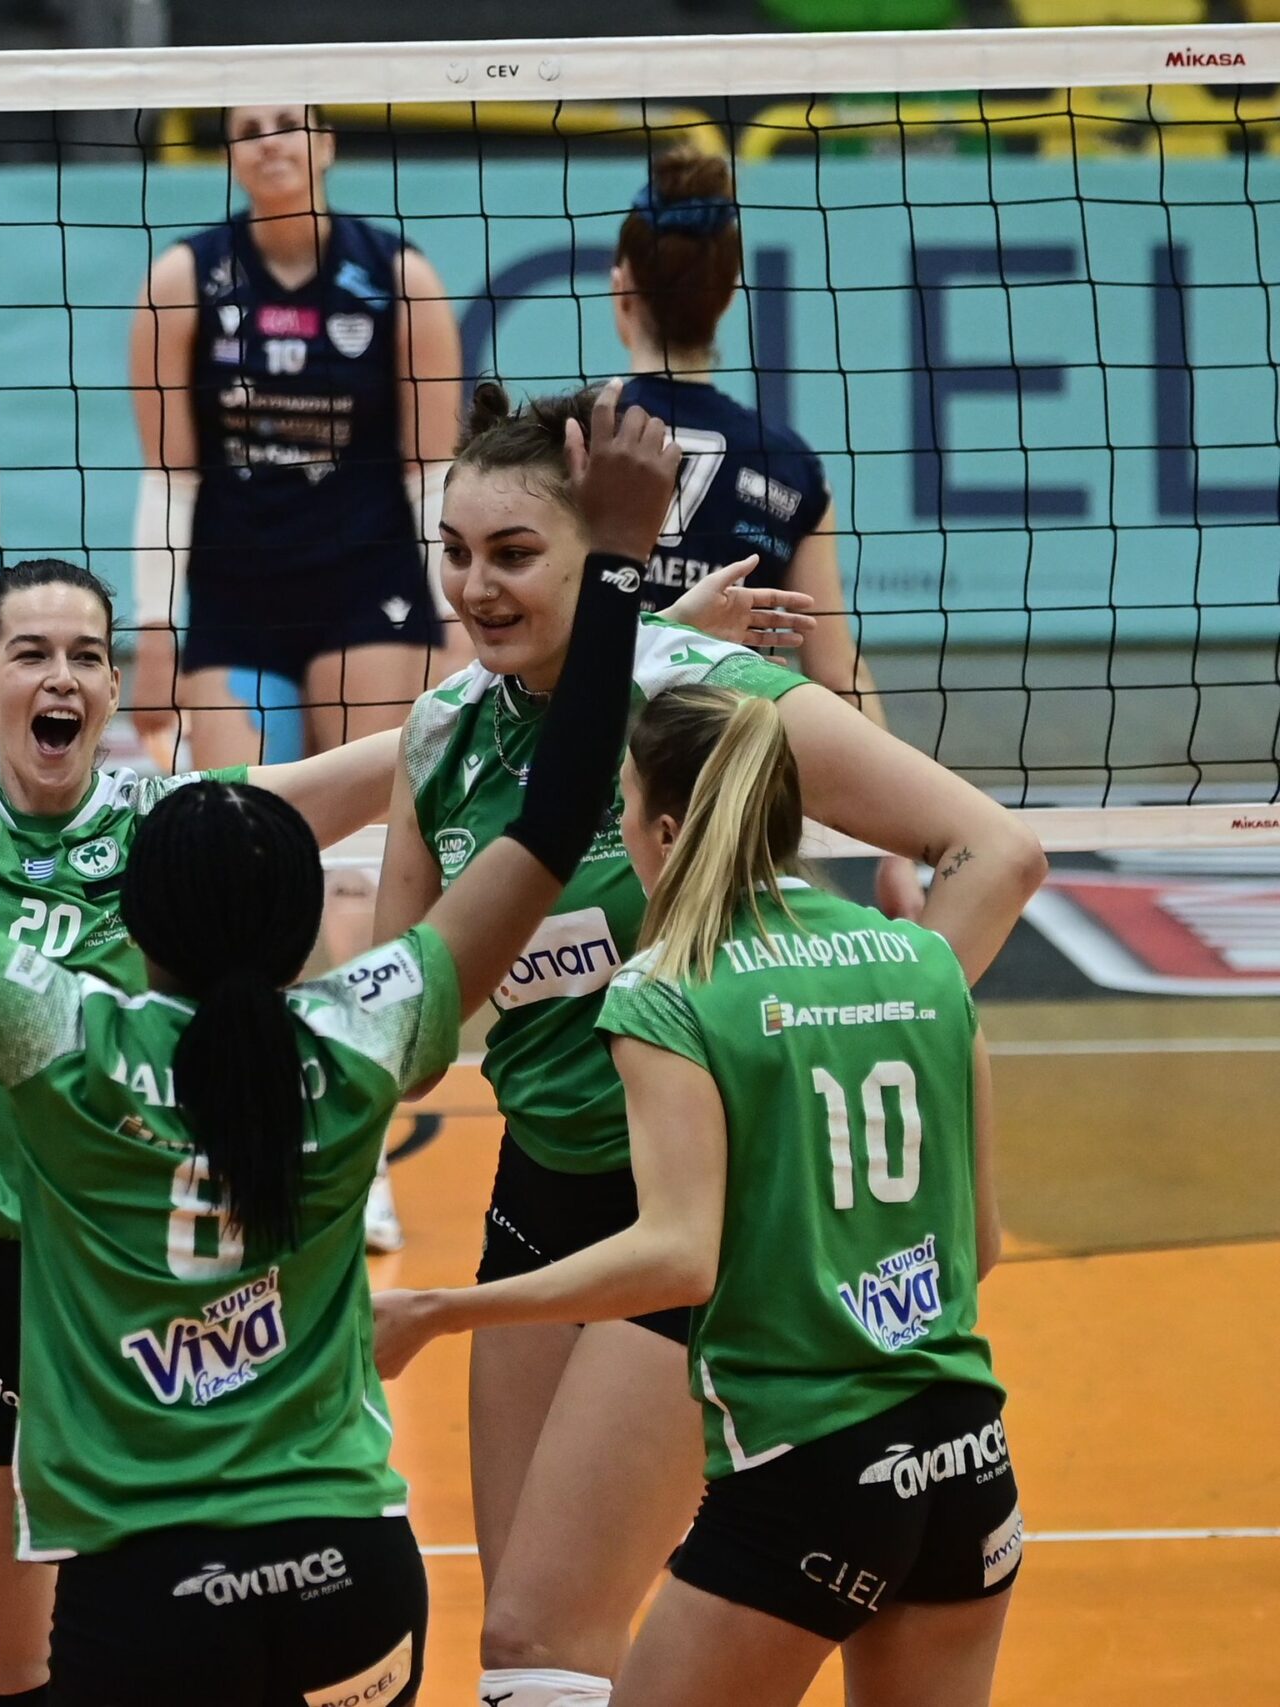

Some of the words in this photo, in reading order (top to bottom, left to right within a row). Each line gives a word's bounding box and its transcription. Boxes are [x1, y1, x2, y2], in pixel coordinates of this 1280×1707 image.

[486, 64, 519, 78] CEV
[8, 897, 82, 958] 20
[721, 928, 920, 974] ΠΑΠΑΦΩΤΙΟΥ
[811, 1060, 922, 1210] 10
[205, 1269, 278, 1324] χυμοί
[128, 1299, 282, 1398] Viva
[194, 1359, 257, 1405] fresh
[893, 1418, 1007, 1500] avance
[976, 1470, 994, 1485] CAR
[204, 1546, 347, 1606] avance
[300, 1589, 320, 1601] CAR
[800, 1551, 887, 1612] CIEL
[363, 1671, 398, 1700] CEL
